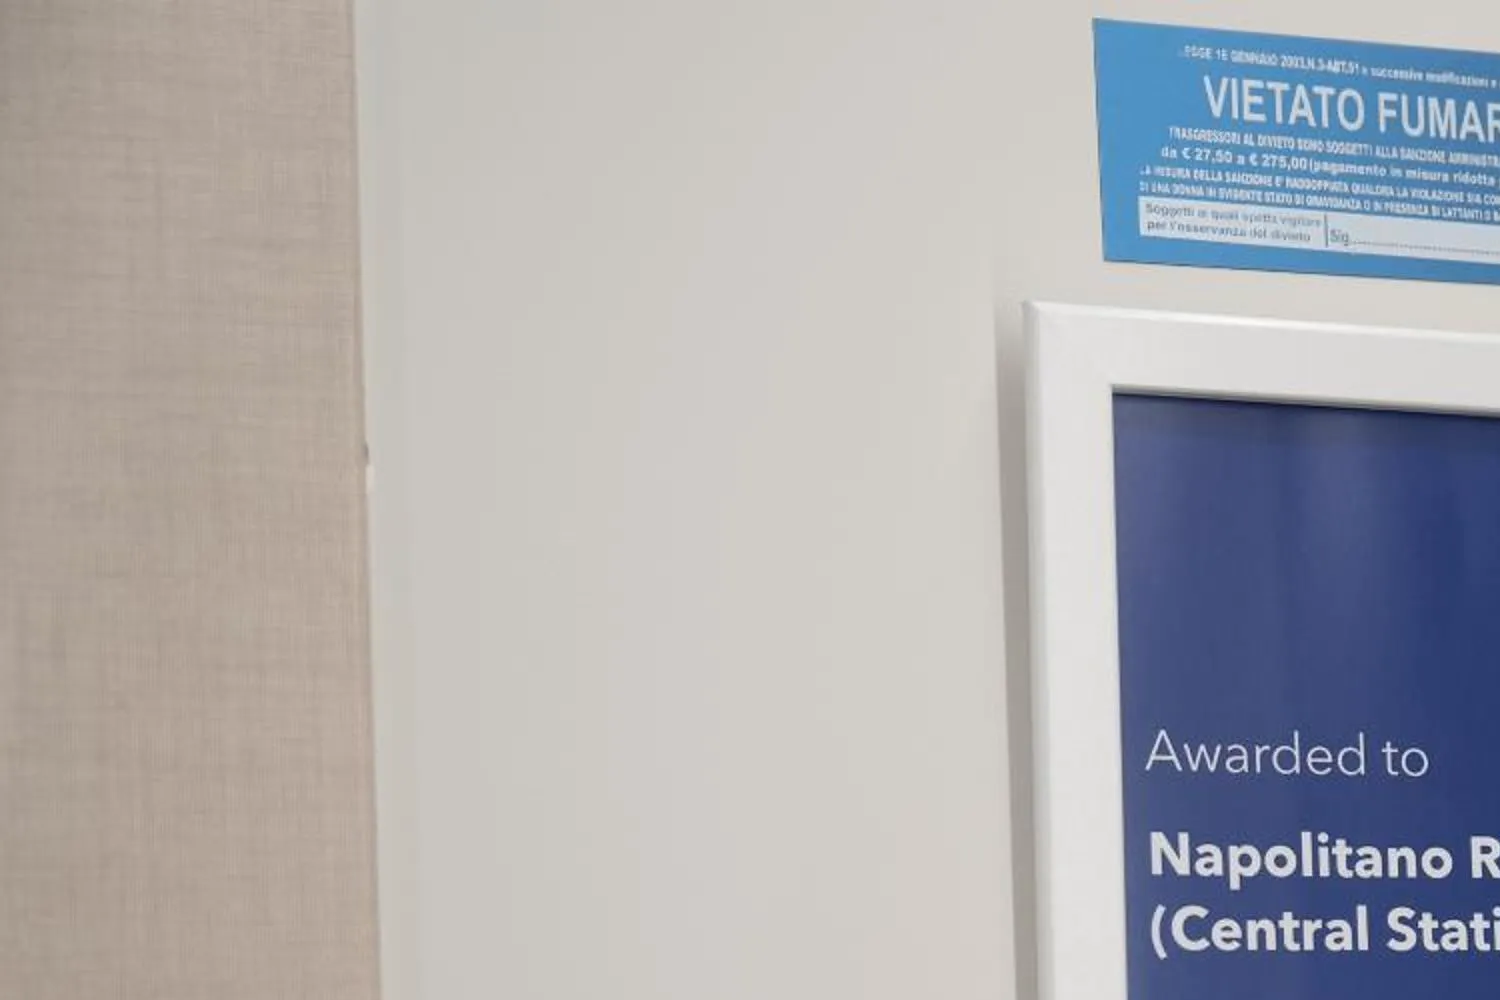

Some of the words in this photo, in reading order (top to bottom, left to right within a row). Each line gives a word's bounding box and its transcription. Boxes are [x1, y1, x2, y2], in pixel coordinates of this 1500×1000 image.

[1203, 75, 1365, 131] VIETATO
[1161, 147, 1177, 159] da
[1182, 148, 1191, 159] €
[1195, 149, 1232, 163] 27,50
[1237, 156, 1245, 165] a
[1249, 154, 1258, 166] €
[1389, 166, 1402, 177] in
[1405, 168, 1449, 182] misura
[1453, 170, 1495, 186] ridotta
[1258, 136, 1295, 149] DIVIETO
[1193, 170, 1222, 182] DELLA
[1145, 728, 1366, 777] Awarded
[1382, 740, 1429, 777] to
[1149, 831, 1453, 890] Napolitano
[1150, 903, 1369, 960] (Central
